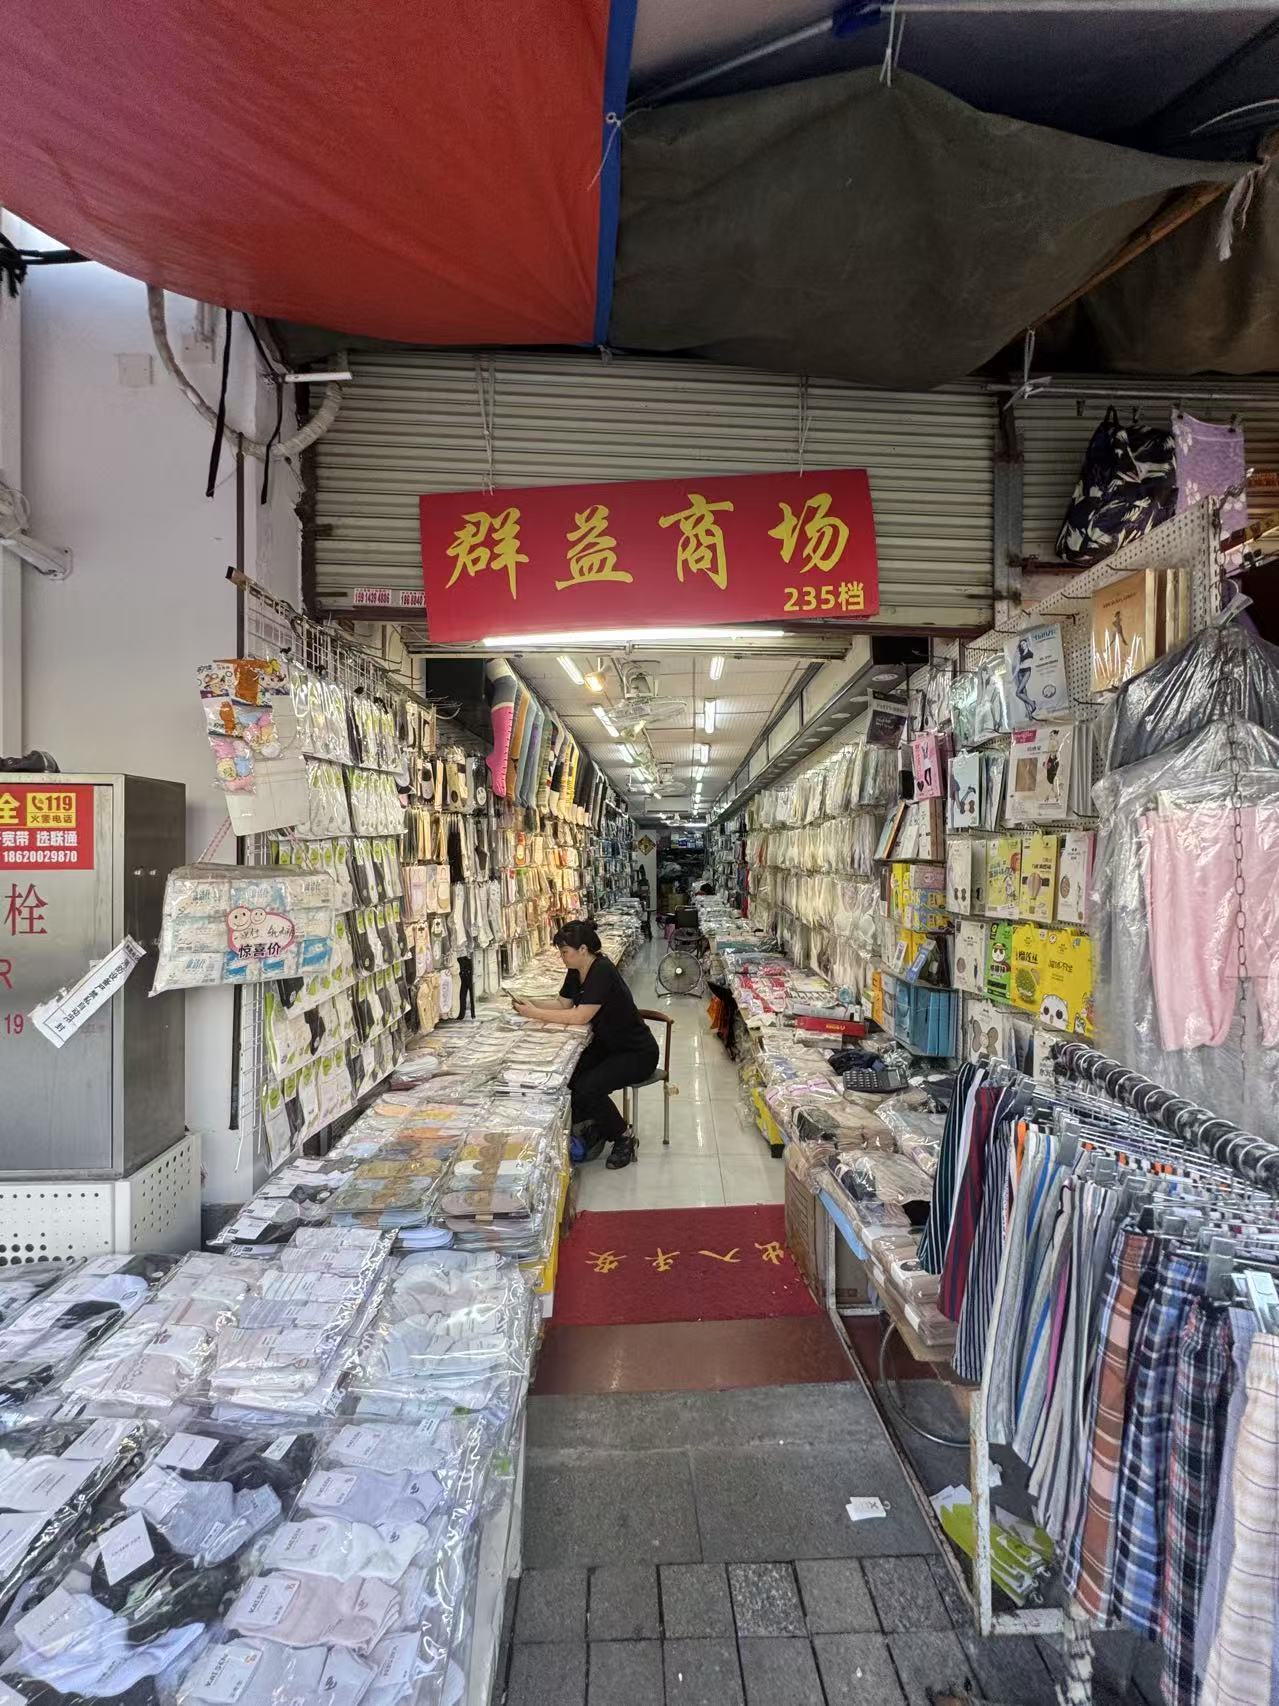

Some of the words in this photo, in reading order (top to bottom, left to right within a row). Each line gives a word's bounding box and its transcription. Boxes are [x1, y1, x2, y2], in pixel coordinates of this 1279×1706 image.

[446, 493, 850, 600] 群益商场
[784, 581, 865, 612] 235档
[45, 795, 73, 812] 119
[30, 814, 73, 824] 火警电话
[0, 830, 30, 847] 宽带
[37, 830, 78, 847] 选联通
[2, 850, 78, 863] 18620029870
[4, 883, 48, 936] 栓
[239, 942, 281, 958] 惊喜价
[584, 1241, 786, 1274] 出入平安
